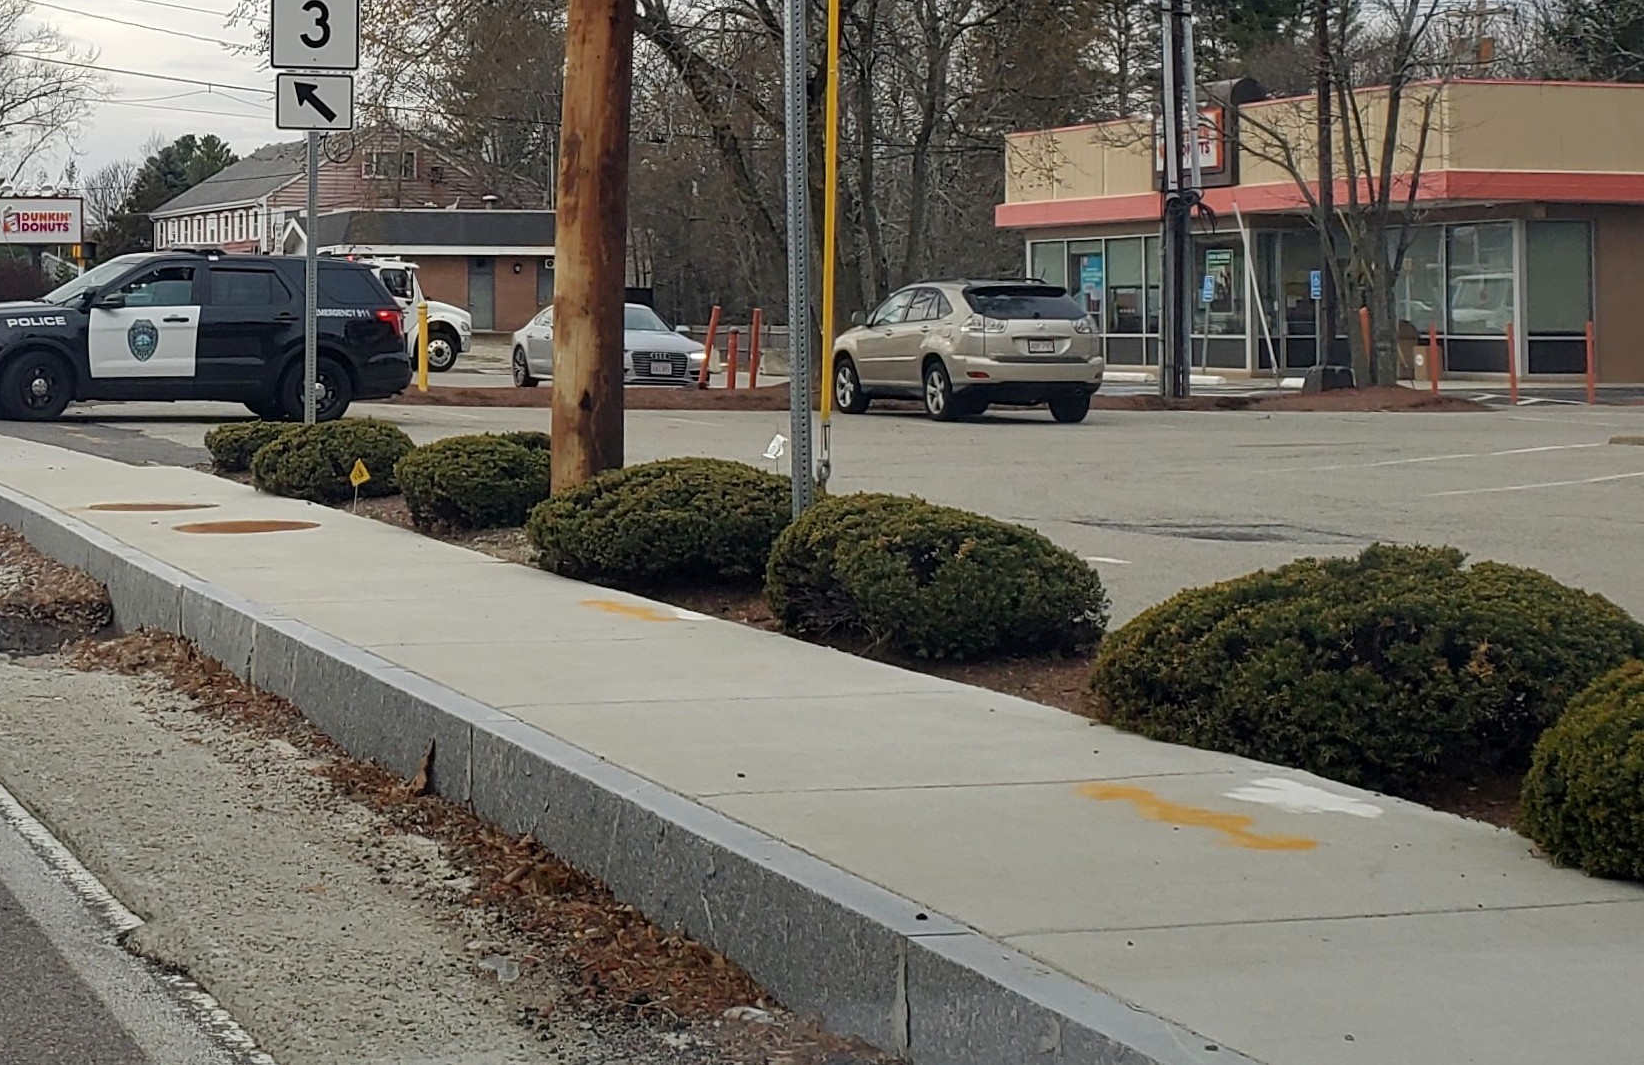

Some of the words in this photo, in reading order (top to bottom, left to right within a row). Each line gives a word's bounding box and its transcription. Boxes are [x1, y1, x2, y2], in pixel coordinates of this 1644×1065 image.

[299, 0, 331, 48] 3
[21, 212, 72, 222] DUNKIN'
[21, 222, 70, 232] DONUTS
[6, 316, 67, 327] POLICE
